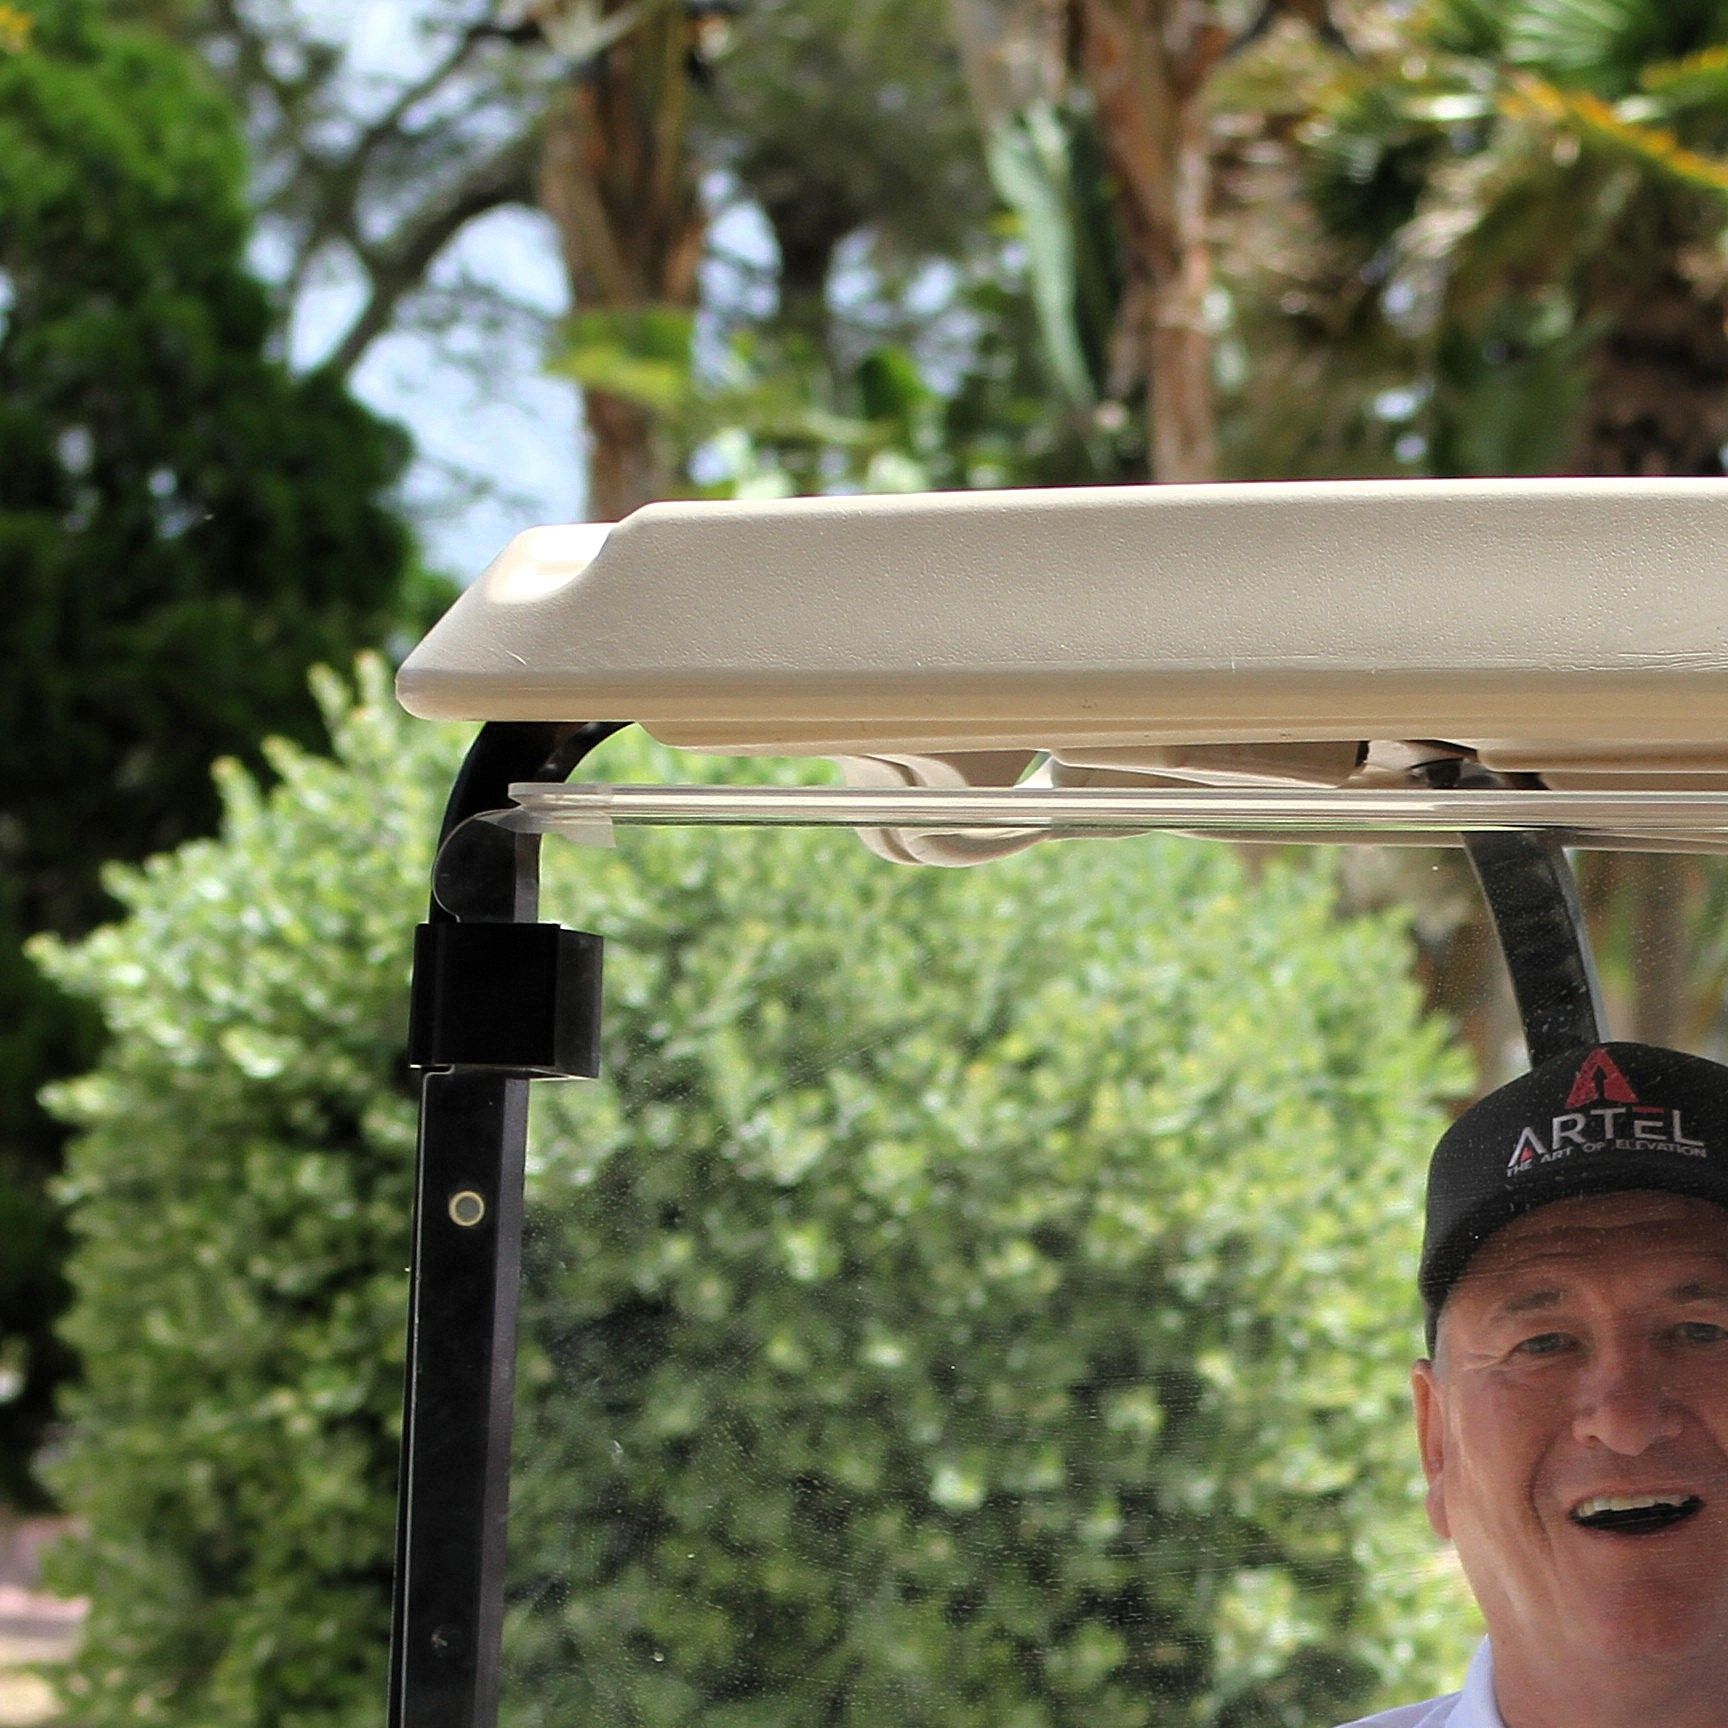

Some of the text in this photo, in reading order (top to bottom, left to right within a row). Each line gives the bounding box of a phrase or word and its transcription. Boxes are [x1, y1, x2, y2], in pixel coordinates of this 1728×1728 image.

[1507, 1105, 1705, 1168] ARTEL
[1540, 1147, 1572, 1164] ART
[1583, 1141, 1606, 1153] OF
[1615, 1138, 1708, 1159] ELEVATION
